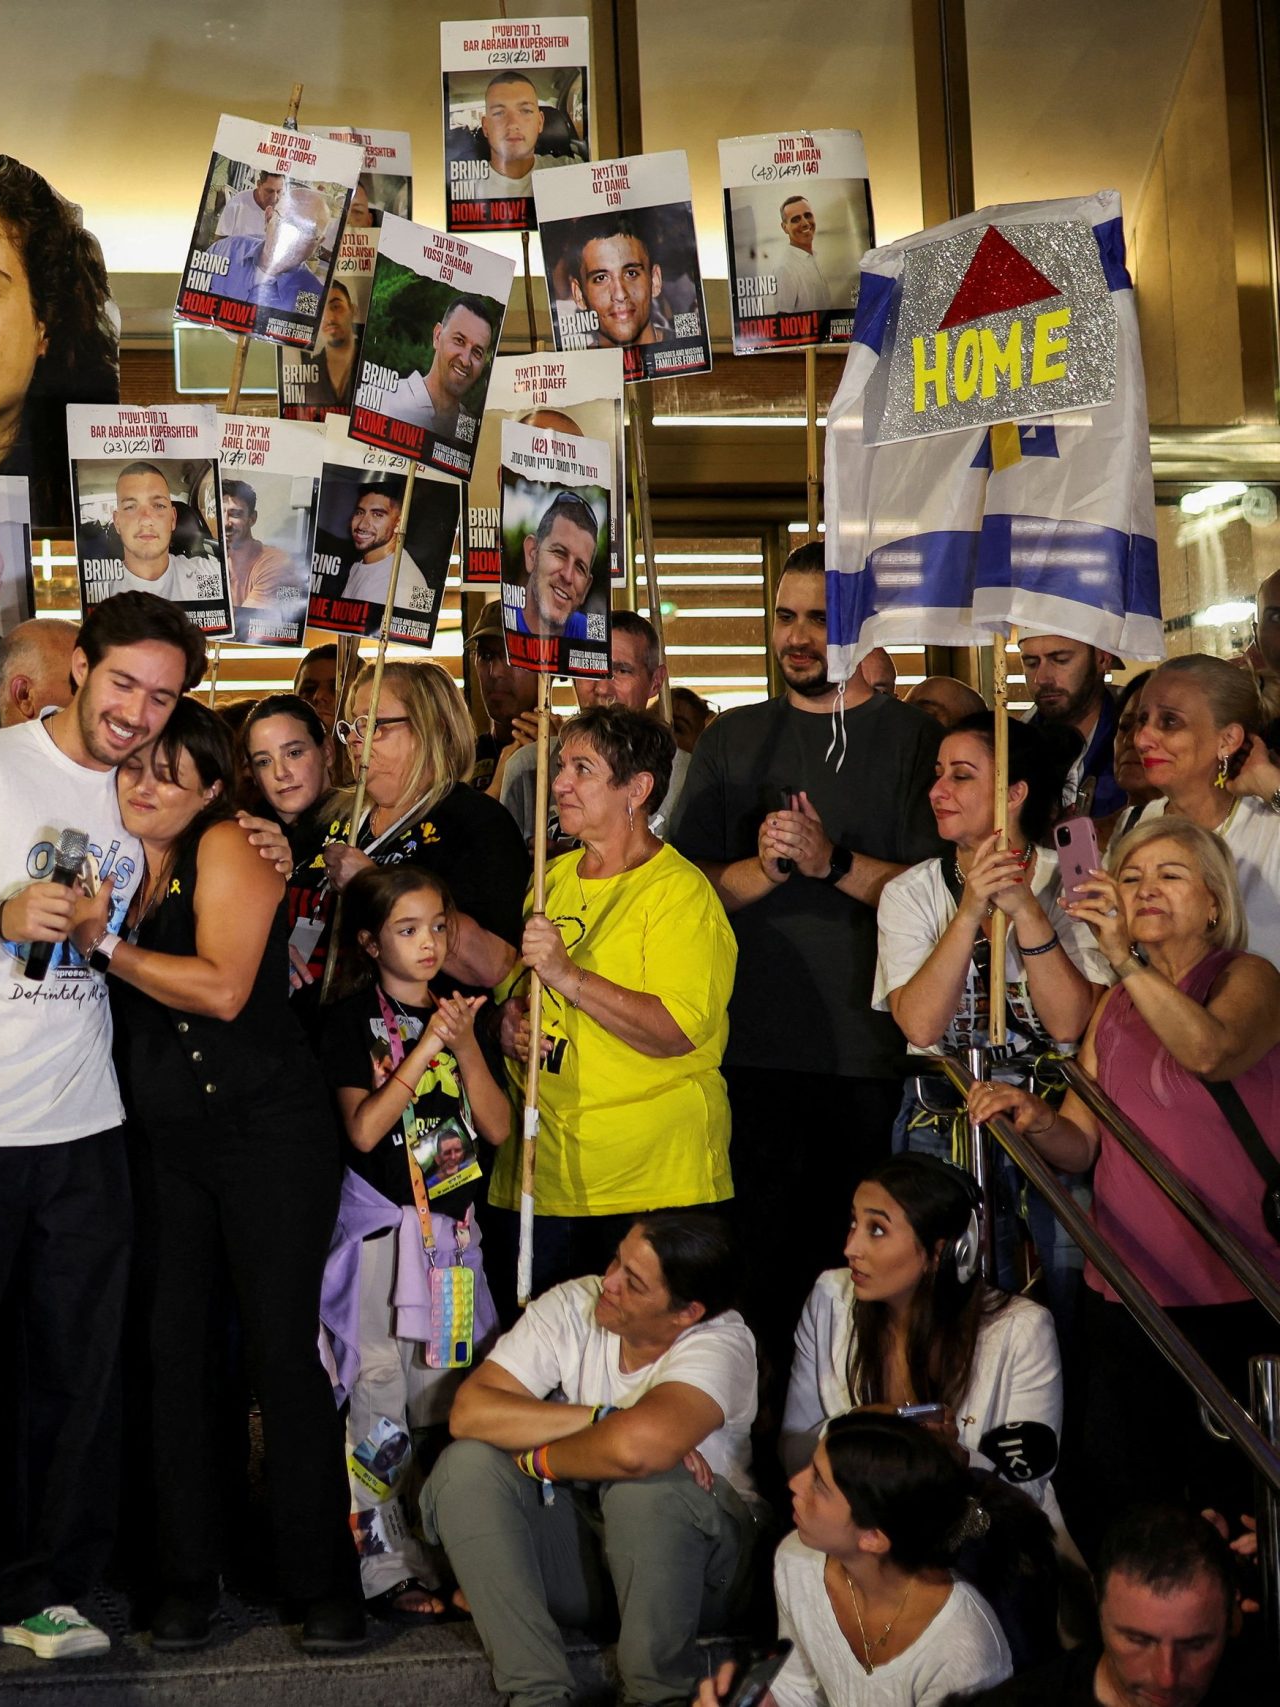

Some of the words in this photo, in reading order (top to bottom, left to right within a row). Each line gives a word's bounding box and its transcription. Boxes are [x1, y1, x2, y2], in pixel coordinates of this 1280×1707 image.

[492, 25, 530, 38] קופרשטיין
[531, 24, 541, 36] בר
[463, 40, 479, 52] BAR
[481, 38, 519, 51] ABRAHAM
[520, 36, 569, 49] KUPERSHTEIN
[270, 131, 288, 147] קופר
[287, 135, 312, 151] עמירם
[257, 142, 288, 159] AMIRAM
[288, 149, 317, 166] COOPER
[773, 151, 794, 164] OMRI
[796, 148, 822, 161] MIRAN
[276, 158, 292, 175] (85)
[450, 160, 490, 181] BRING
[751, 164, 778, 182] (48)
[451, 181, 476, 201] HIM
[592, 181, 604, 194] OZ
[604, 177, 631, 192] DANIEL
[606, 191, 622, 207] (19)
[451, 203, 487, 222] HOME
[491, 199, 527, 221] NOW!
[432, 234, 456, 253] שרעבי
[456, 242, 469, 258] יוסי
[190, 249, 230, 276] BRING
[423, 245, 444, 264] YOSSI
[444, 253, 473, 276] SHARABI
[185, 269, 213, 293] HIM
[439, 265, 454, 283] (53)
[736, 275, 778, 297] BRING
[181, 291, 219, 317] HOME
[220, 299, 259, 326] NOW!
[738, 297, 765, 318] HIM
[265, 323, 292, 338] FAMILIES
[291, 329, 313, 341] FORUM
[559, 310, 600, 337] BRING
[739, 318, 778, 340] HOME
[780, 311, 819, 337] NOW!
[561, 333, 587, 351] HIM
[542, 364, 565, 378] ליאור
[655, 356, 683, 370] FAMILIES
[682, 352, 705, 365] FORUM
[912, 308, 1071, 414] HOME
[283, 364, 320, 384] BRING
[361, 360, 400, 393] BRING
[283, 384, 306, 404] HIM
[359, 383, 383, 412] HIM
[118, 411, 159, 425] קופרשטיין
[159, 411, 169, 424] בר
[90, 425, 107, 438] BAR
[108, 425, 148, 438] ABRAHAM
[150, 425, 199, 438] KUPERSHTEIN
[224, 423, 244, 437] קוניו
[246, 424, 271, 439] אריאל
[354, 408, 389, 438] HOME
[389, 419, 426, 450] NOW!
[221, 437, 244, 450] ARIEL
[246, 438, 271, 453] CUNIO
[531, 436, 549, 456] (42)
[567, 442, 577, 459] טל
[431, 448, 454, 467] FAMILIES
[452, 457, 470, 473] FORUM
[537, 457, 555, 470] עדיין
[469, 507, 500, 528] BRIN
[469, 528, 495, 549] HIM
[83, 558, 124, 581] BRING
[312, 553, 342, 576] RING
[470, 550, 500, 573] HOM
[85, 581, 111, 604] HIM
[502, 582, 526, 609] BRING
[204, 616, 227, 628] FORUM
[330, 601, 370, 624] NOW!
[504, 605, 518, 632] HIM
[408, 626, 430, 640] FORUM
[526, 637, 559, 663] NOW!
[569, 656, 590, 669] FAMILIES
[589, 659, 608, 671] FORUM
[26, 841, 136, 890] ois
[8, 983, 85, 1010] Definitely
